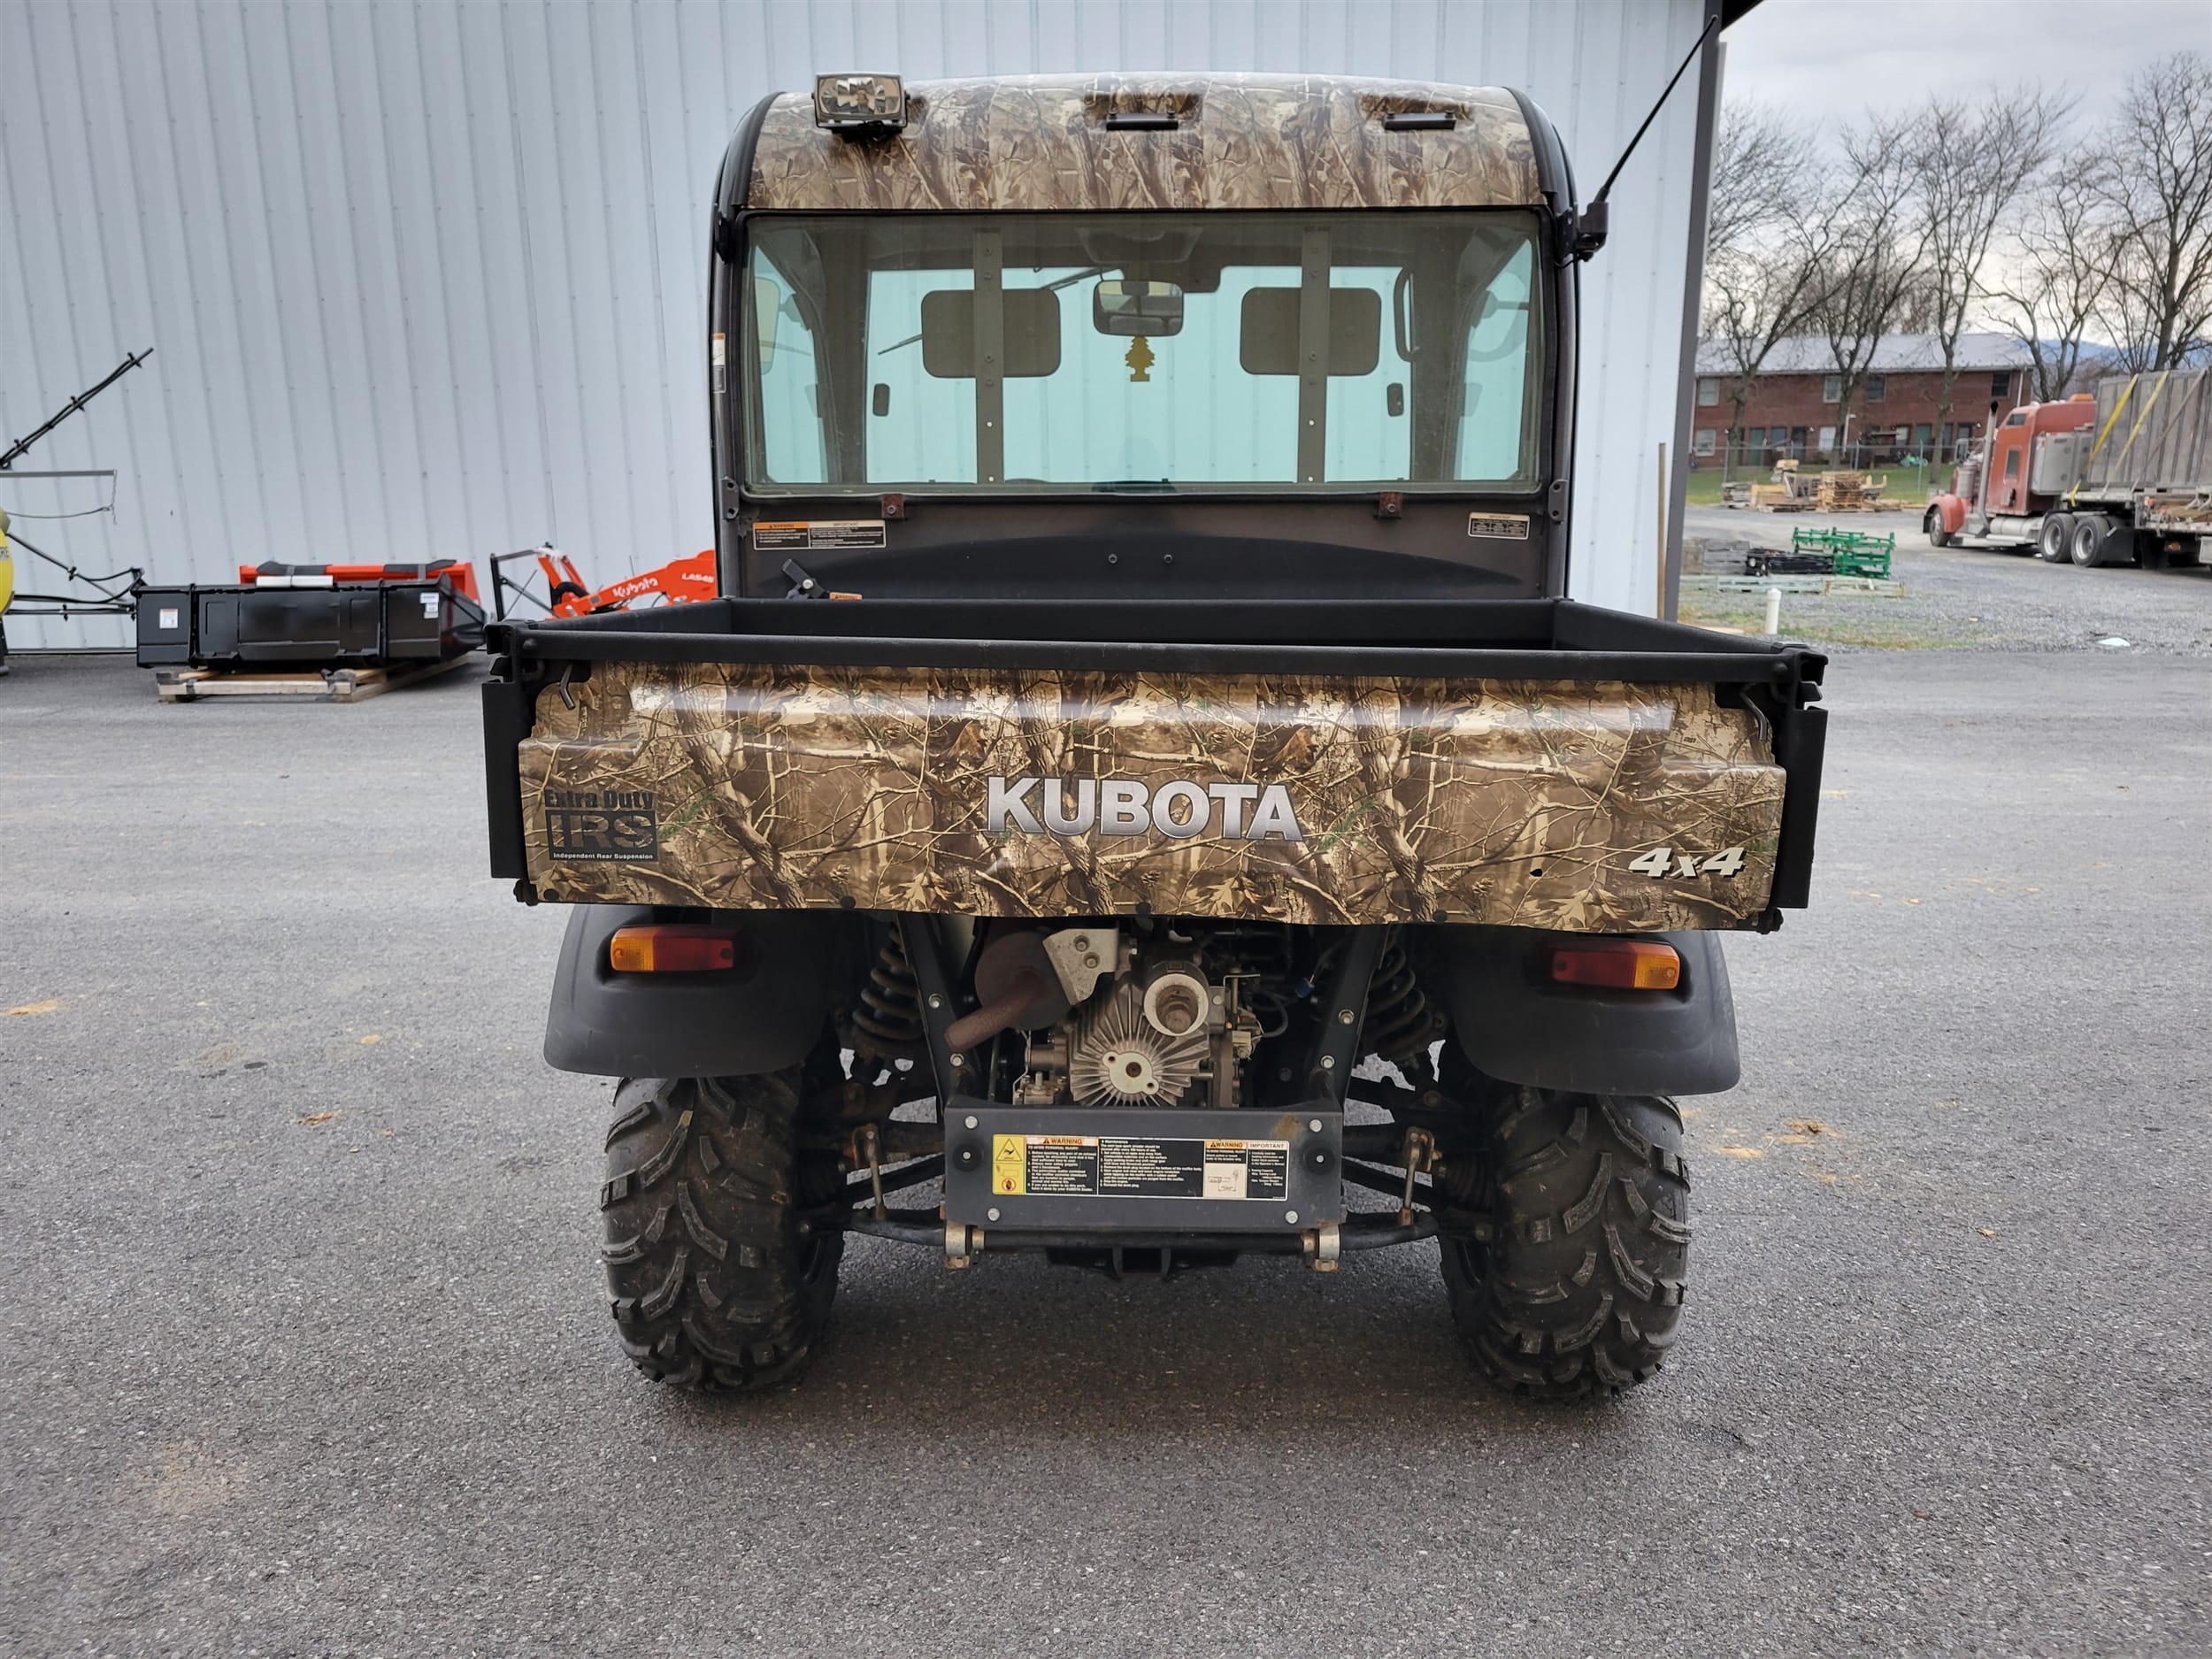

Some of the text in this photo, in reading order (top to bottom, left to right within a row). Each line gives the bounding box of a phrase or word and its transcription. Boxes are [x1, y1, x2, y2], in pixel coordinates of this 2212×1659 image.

[612, 577, 658, 597] Kubota
[544, 788, 654, 810] Extra Duty
[987, 775, 1303, 841] KUBOTA
[550, 814, 654, 849] IRS
[1628, 847, 1746, 879] 4x4
